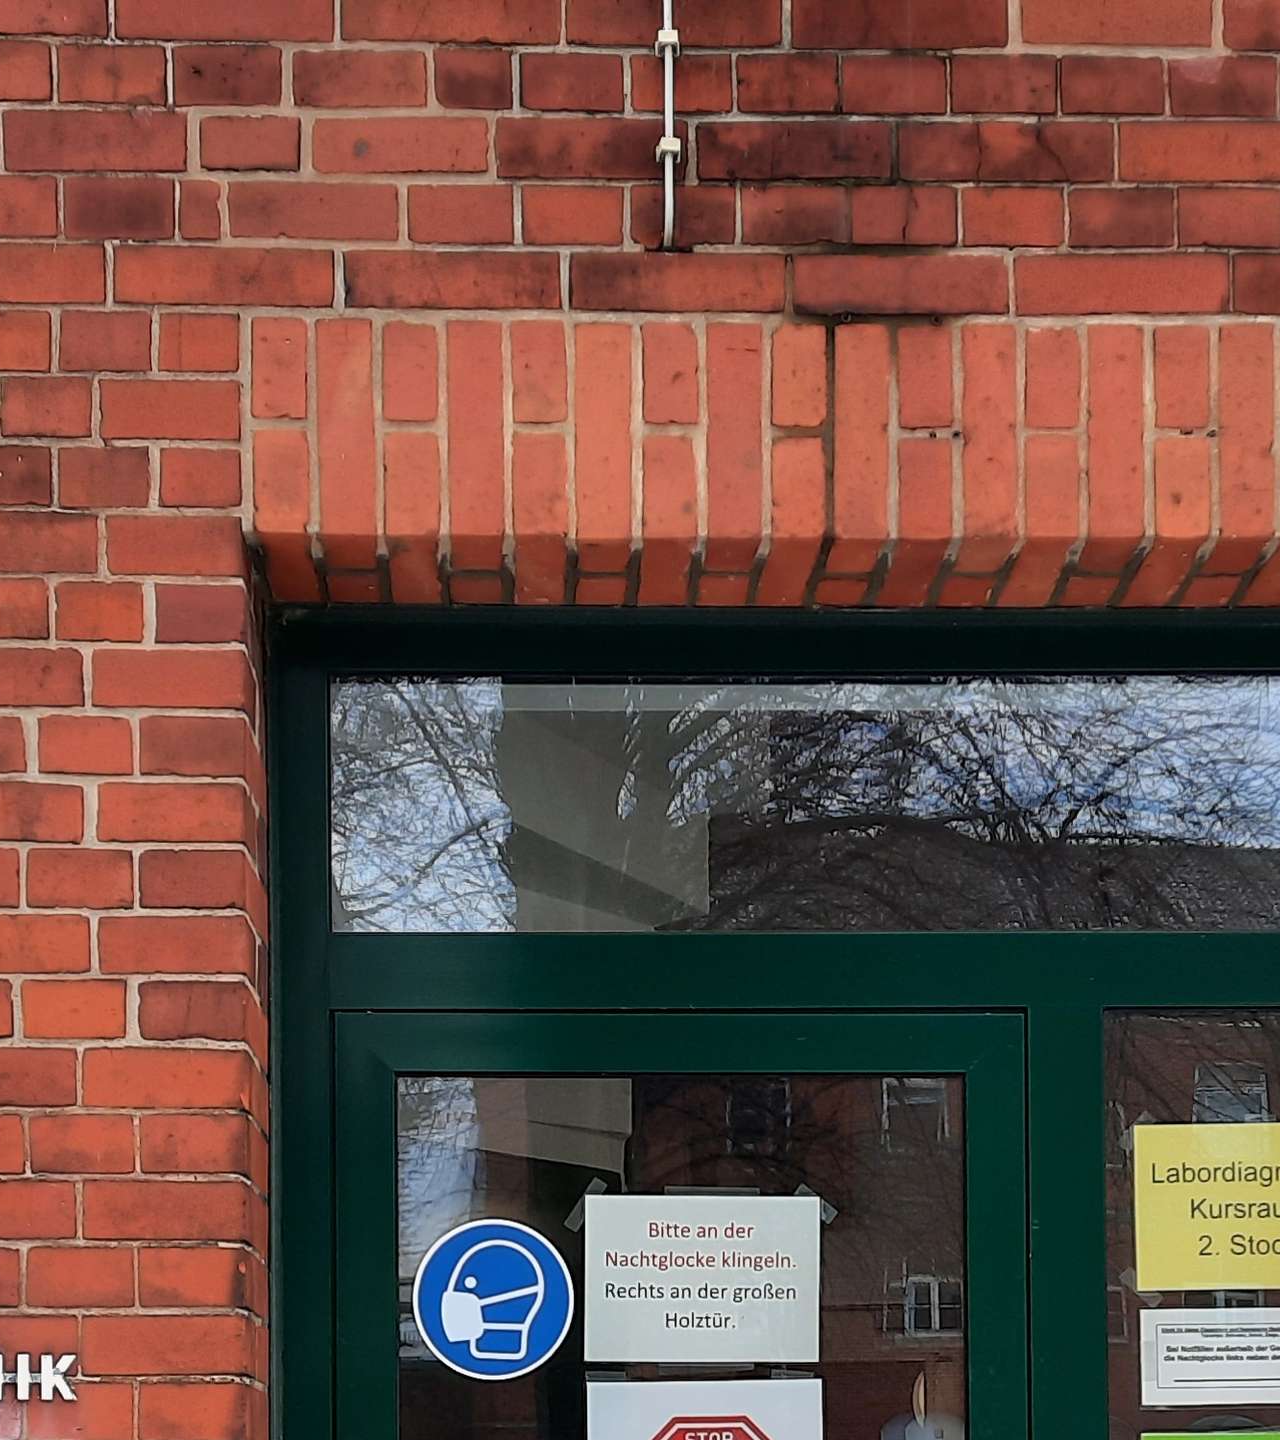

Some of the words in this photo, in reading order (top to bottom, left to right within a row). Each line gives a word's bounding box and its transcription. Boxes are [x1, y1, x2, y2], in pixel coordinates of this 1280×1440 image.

[649, 1222, 691, 1238] Bitte
[696, 1226, 718, 1238] an
[724, 1222, 754, 1238] der
[1198, 1235, 1220, 1256] 2.
[605, 1251, 716, 1271] Nachtglocke
[722, 1251, 797, 1271] klingeln.
[605, 1282, 665, 1299] Rechts
[670, 1286, 691, 1299] an
[698, 1283, 728, 1299] der
[733, 1283, 797, 1303] großen
[665, 1312, 736, 1329] Holztür.
